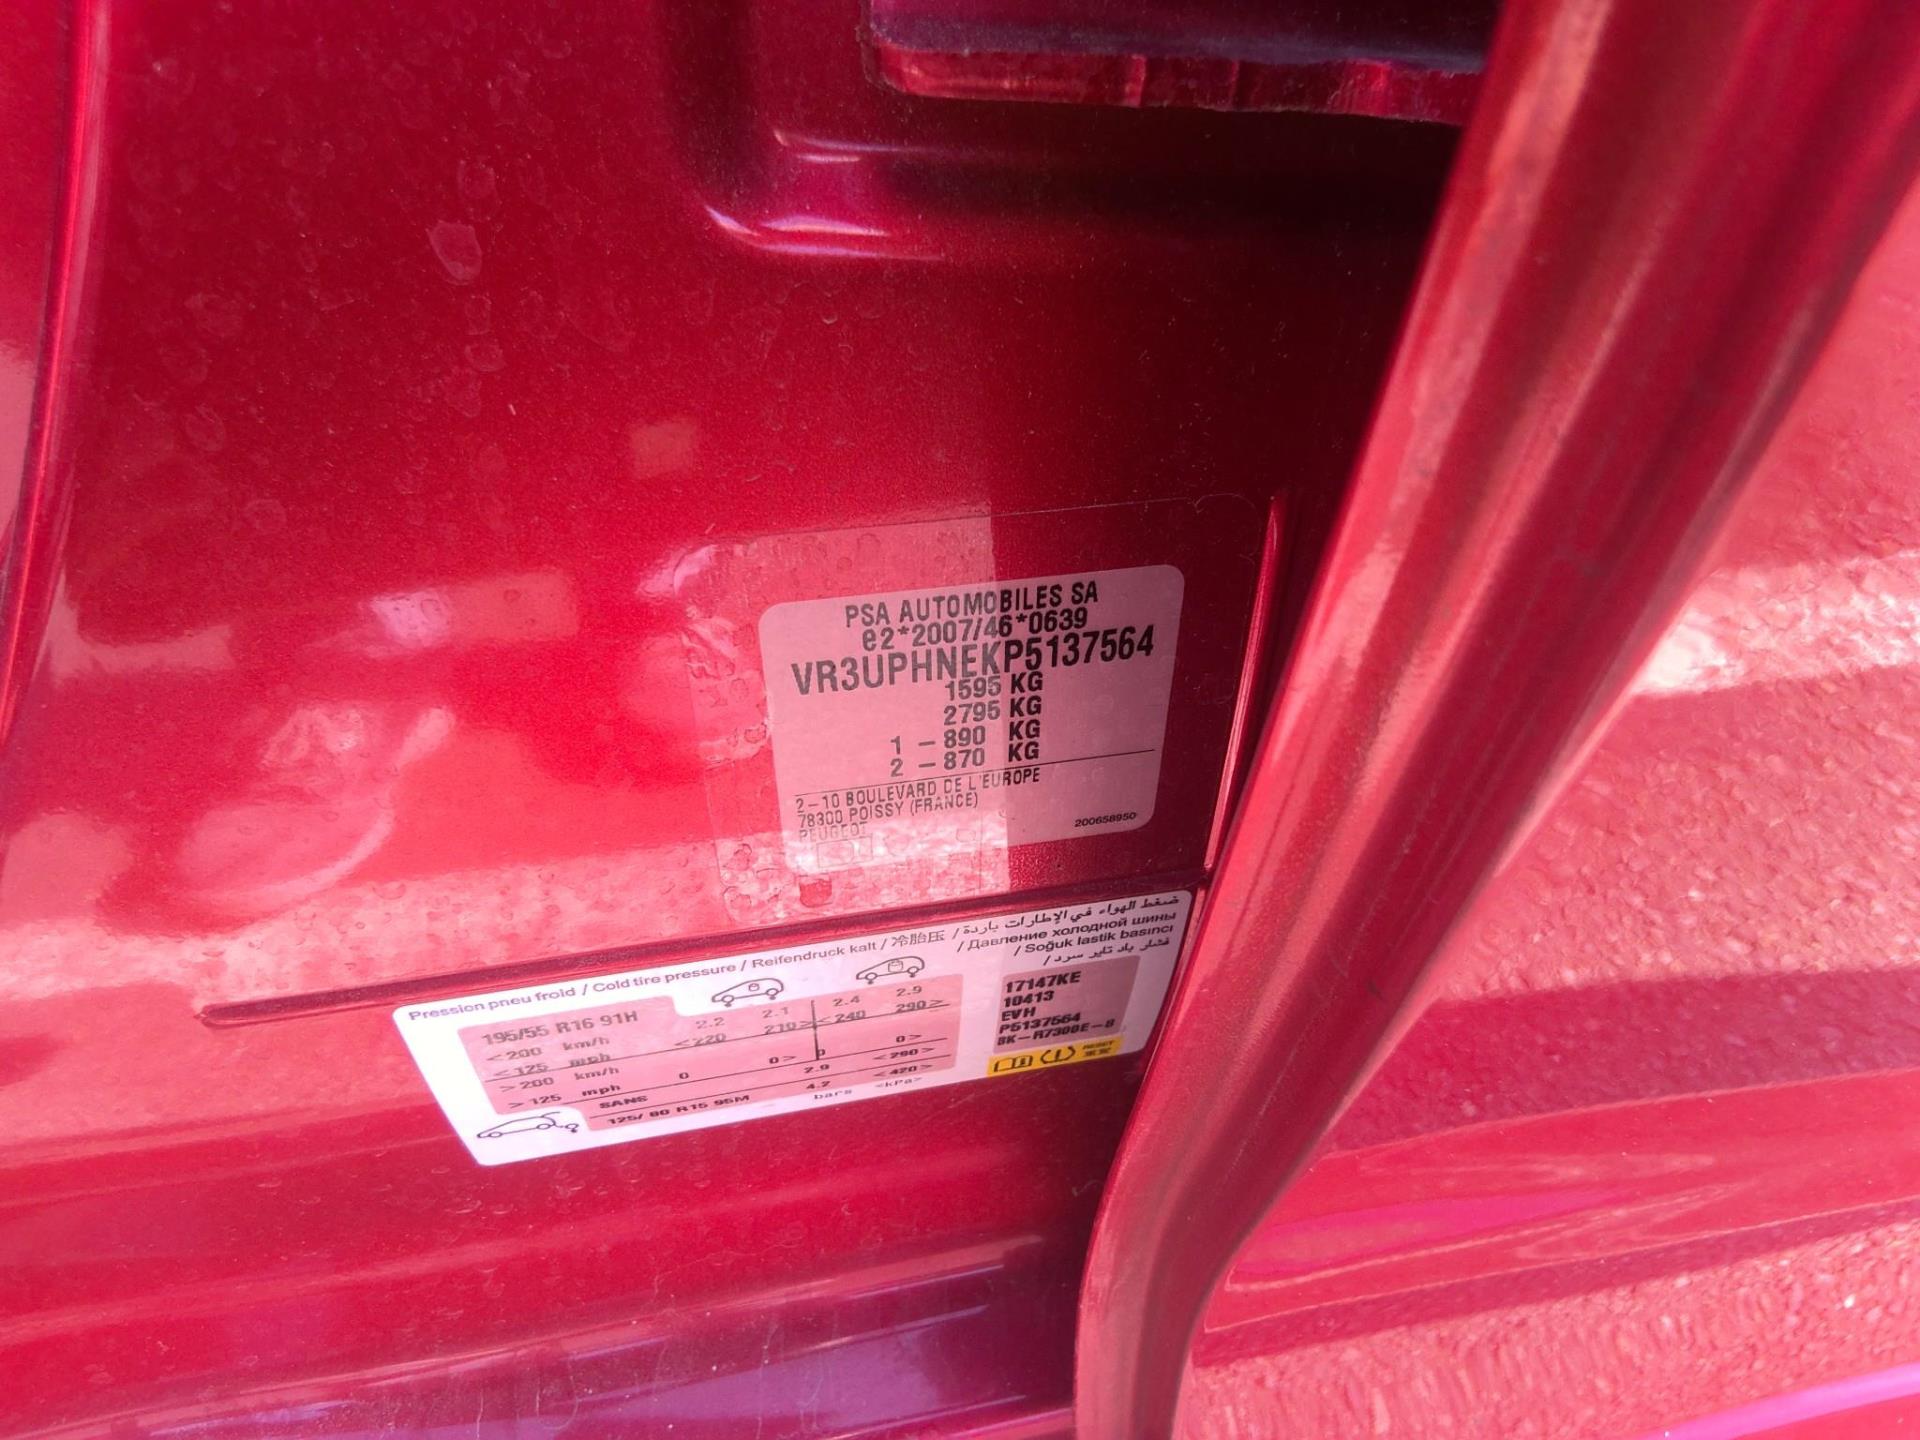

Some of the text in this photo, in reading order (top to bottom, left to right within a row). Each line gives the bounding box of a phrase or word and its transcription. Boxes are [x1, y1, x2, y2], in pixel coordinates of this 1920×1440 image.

[845, 580, 1098, 628] PSA AUTOMOBILES SA
[791, 625, 1154, 695] VR3UPHNEKP5137564
[944, 671, 1043, 700] 1595 KG
[943, 695, 1042, 726] 2795 KG
[891, 735, 901, 755] 1
[1008, 719, 1041, 741] KG
[890, 758, 903, 778] 2
[1008, 741, 1040, 763] KG
[845, 781, 937, 807] BOULEVARD
[944, 777, 963, 794] DE
[799, 791, 979, 829] 78300 POISSY (FRANCE)
[1074, 812, 1137, 828] 200658950
[799, 821, 867, 842] PEUGEOT
[1140, 895, 1180, 910] ضغط
[1070, 907, 1092, 922] في
[891, 930, 946, 947] 冷胎压
[968, 930, 1048, 951] Давление
[1052, 917, 1128, 938] холодной
[1131, 911, 1177, 926] шины
[1025, 937, 1072, 954] Soğuk
[1077, 931, 1117, 945] lastik
[408, 1001, 485, 1021] Pression
[488, 994, 532, 1011] pneu
[534, 987, 576, 1002] froid
[592, 978, 630, 993] Cold
[635, 972, 661, 986] tire
[665, 964, 737, 984] pressure
[752, 946, 845, 969] Reifendruck
[849, 940, 877, 954] kalt
[1006, 970, 1081, 993] 17147KE
[695, 985, 923, 1030] 2.2 2.1 2.4 2.9
[1003, 990, 1055, 1008] 10413
[999, 1011, 1081, 1034] P5137564
[1001, 1006, 1036, 1022] EVH
[482, 1011, 639, 1046] 195/55 R16 91H
[562, 1036, 610, 1051] km/h
[568, 1053, 611, 1068] mph
[574, 1066, 620, 1081] km/h
[581, 1083, 621, 1098] mph
[599, 1095, 648, 1109] SANS
[676, 1102, 709, 1114] R15
